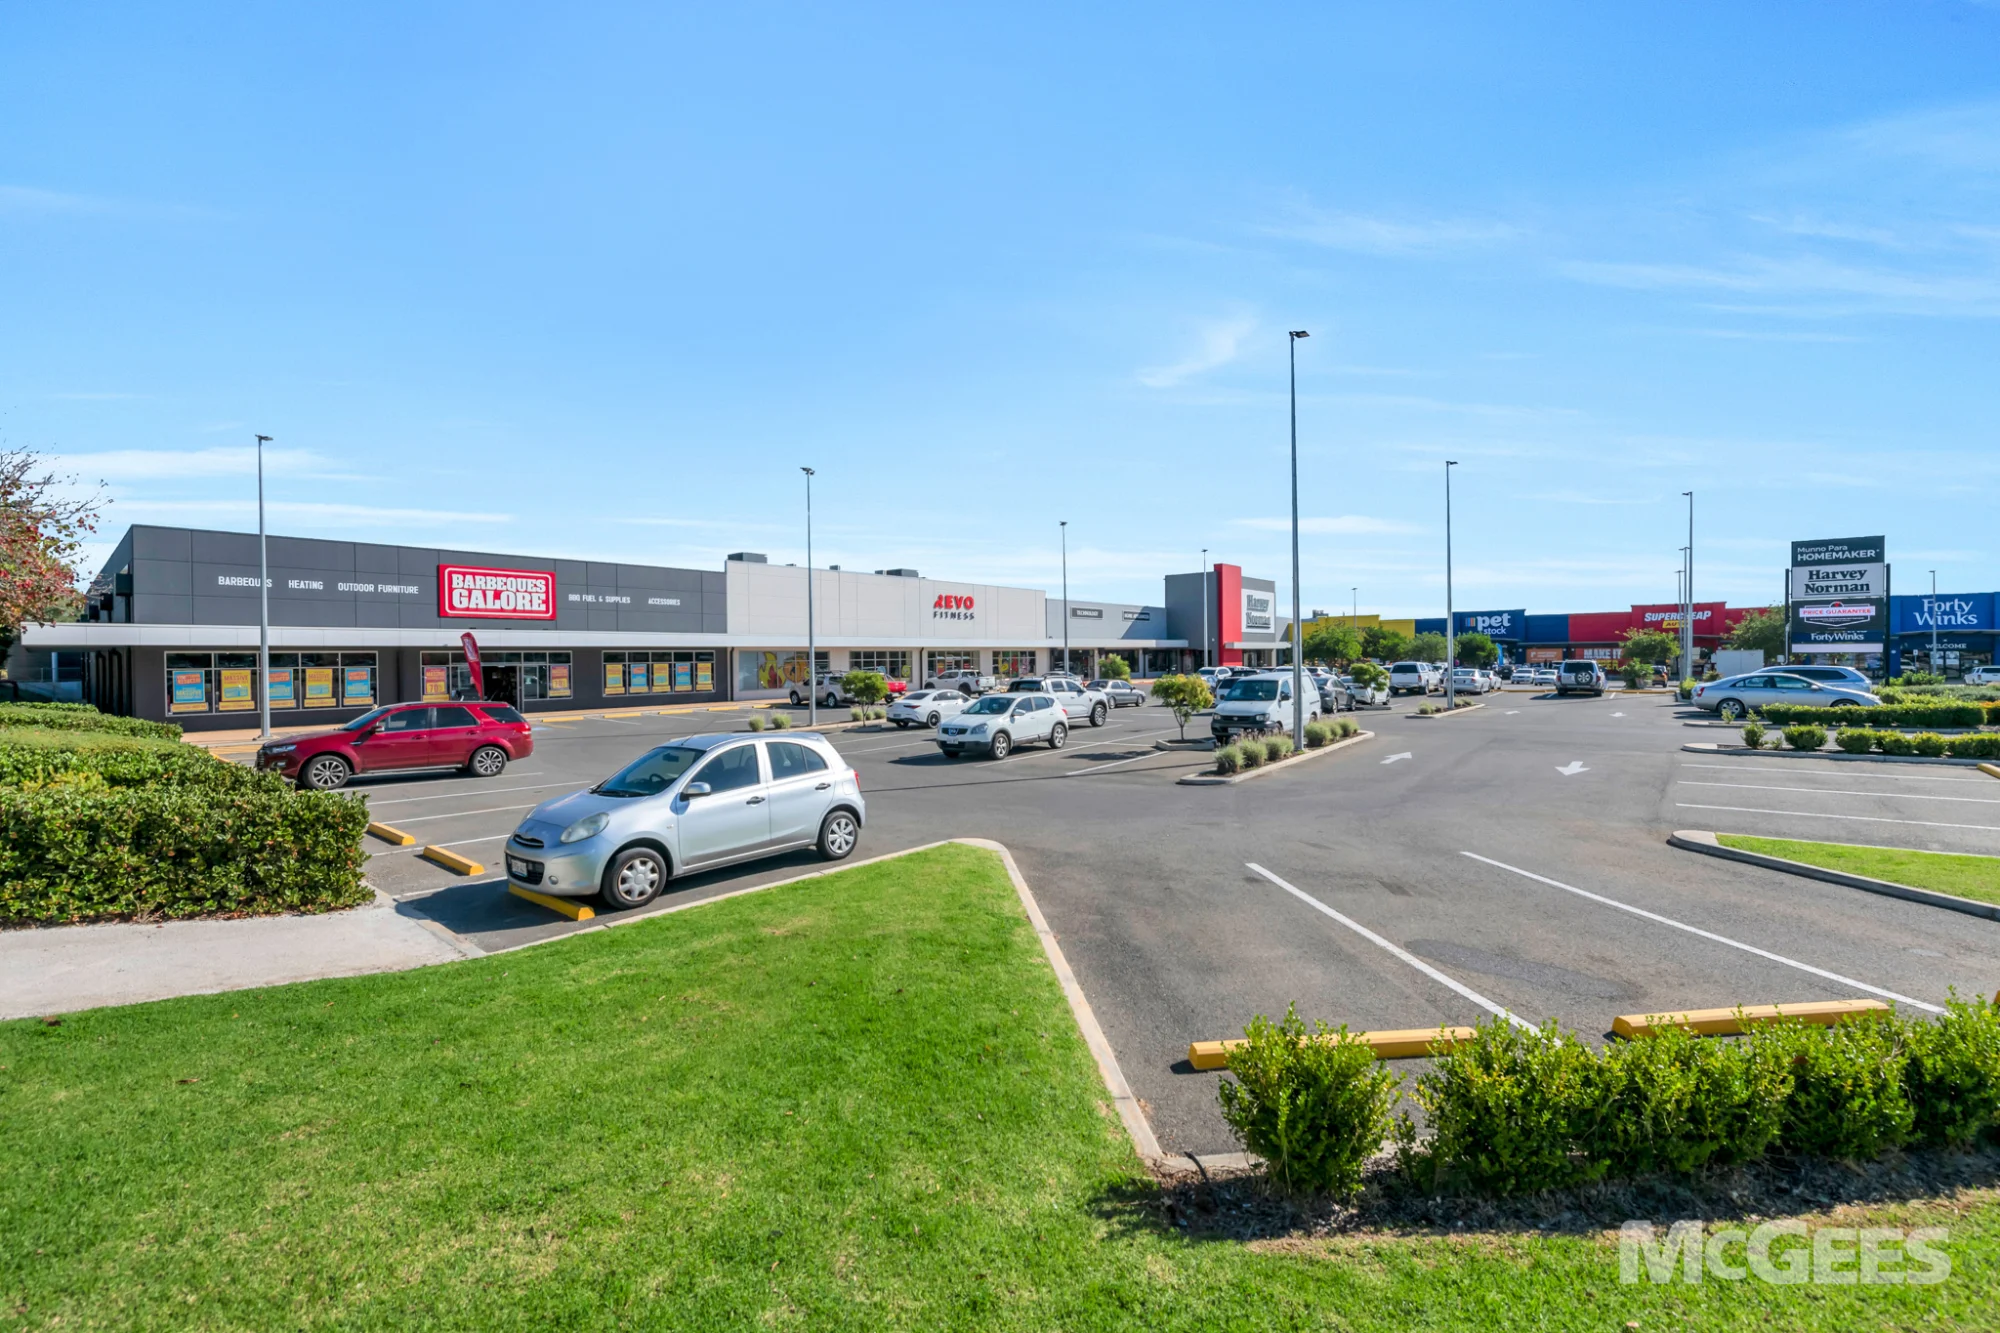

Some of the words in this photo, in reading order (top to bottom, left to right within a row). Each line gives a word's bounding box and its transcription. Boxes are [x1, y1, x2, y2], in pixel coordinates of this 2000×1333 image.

[1797, 549, 1876, 562] HOMEMAKER
[1808, 569, 1868, 581] Harvey
[218, 575, 273, 588] BARBEQUS
[288, 579, 324, 590] HEATING
[451, 573, 546, 592] BARBEQUES
[338, 582, 375, 593] OUTDOOR
[378, 584, 419, 594] FURNITURE
[1804, 583, 1870, 594] Norman
[452, 588, 547, 611] GALORE
[582, 594, 597, 603] FUEL
[605, 596, 631, 604] SUPPLIES
[648, 597, 681, 606] ACCESSORIES
[1921, 598, 1973, 615] Forty
[933, 611, 975, 621] FITNESS
[1476, 612, 1511, 632] pet
[1644, 610, 1712, 622] SUPERCEAP
[1913, 611, 1978, 626] Winks
[1483, 626, 1507, 635] stock
[1583, 648, 1611, 659] MAKE
